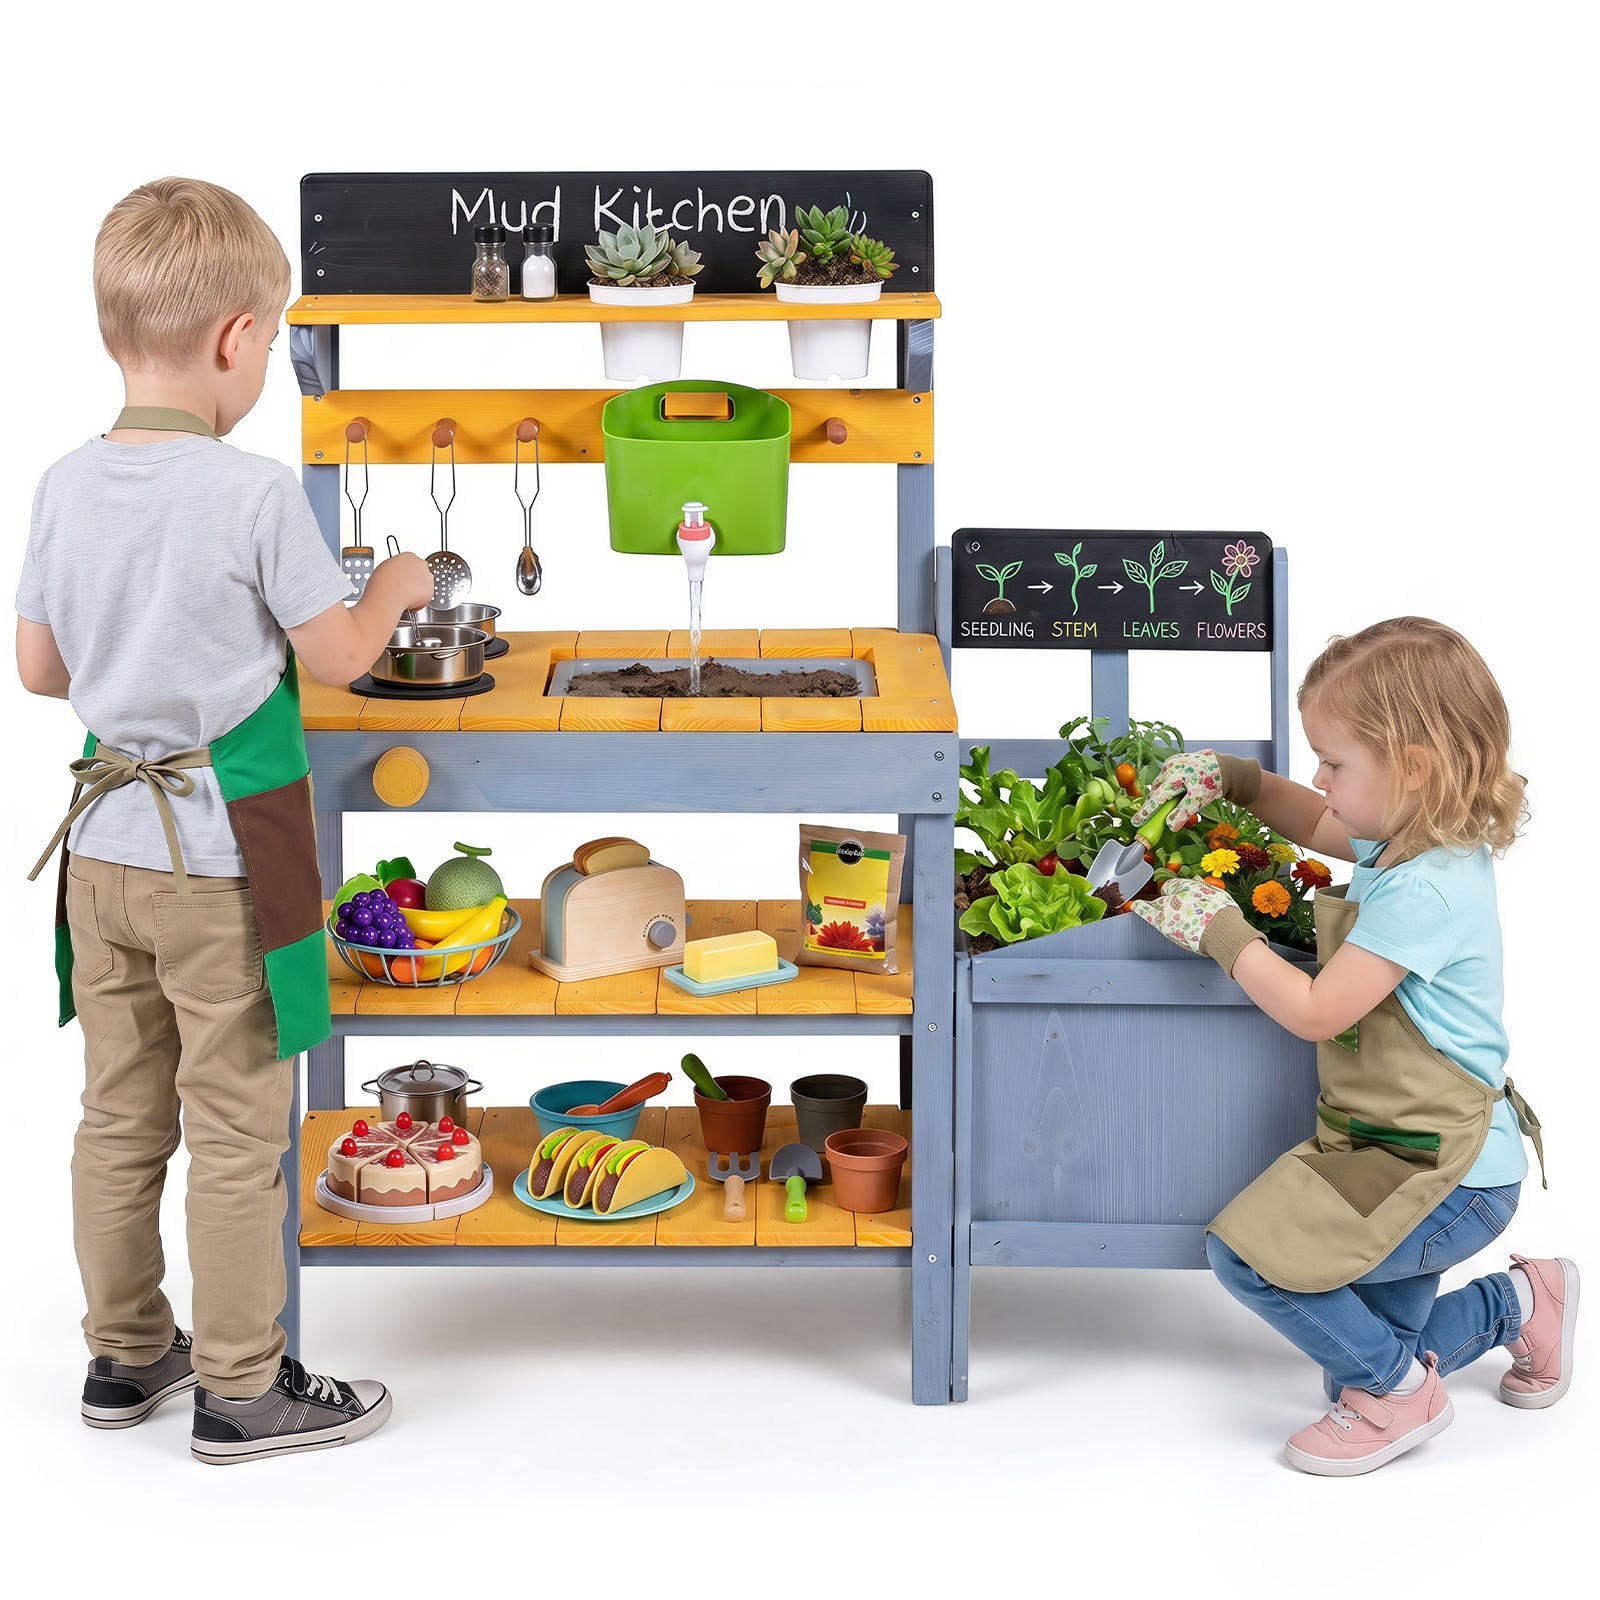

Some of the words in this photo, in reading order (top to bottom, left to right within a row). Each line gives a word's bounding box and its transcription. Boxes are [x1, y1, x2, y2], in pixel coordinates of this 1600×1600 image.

[451, 185, 561, 242] Mud
[593, 184, 787, 235] Kitchen
[960, 621, 1034, 638] SEEDLING
[1052, 621, 1098, 638] STEM
[1123, 621, 1180, 638] LEAVES
[1197, 622, 1267, 639] FLOWERS
